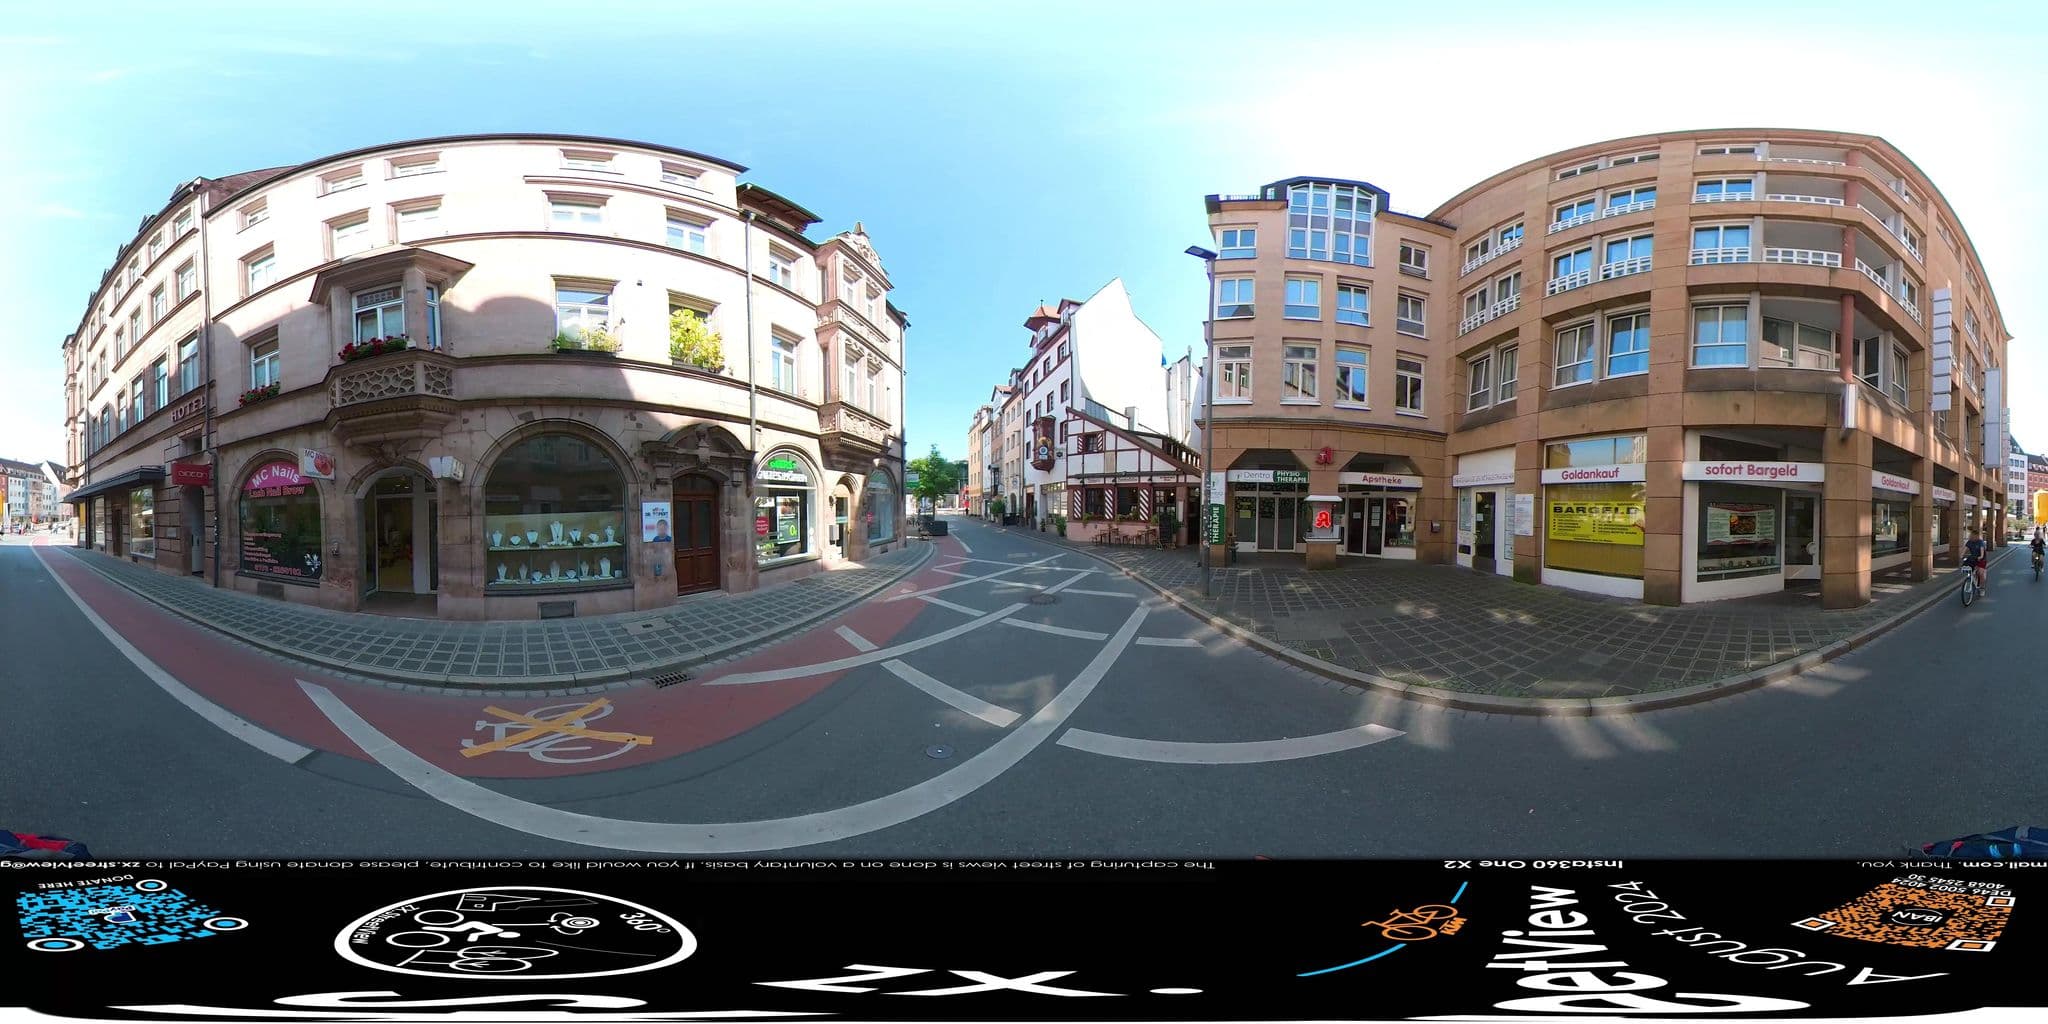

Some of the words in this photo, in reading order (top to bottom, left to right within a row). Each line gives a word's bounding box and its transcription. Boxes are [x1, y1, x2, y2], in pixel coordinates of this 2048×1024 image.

[171, 396, 206, 422] HOTEL
[251, 469, 269, 488] MC
[271, 465, 301, 483] Nails
[1243, 471, 1270, 479] Dentro
[1561, 467, 1620, 480] Goldankauf
[1705, 463, 1743, 475] sofort
[1746, 464, 1798, 479] Bargeld
[1362, 474, 1402, 485] Apotheke
[1881, 475, 1910, 490] Goldankauf
[1553, 506, 1640, 515] BARGELD
[1212, 506, 1220, 543] THERAPIE
